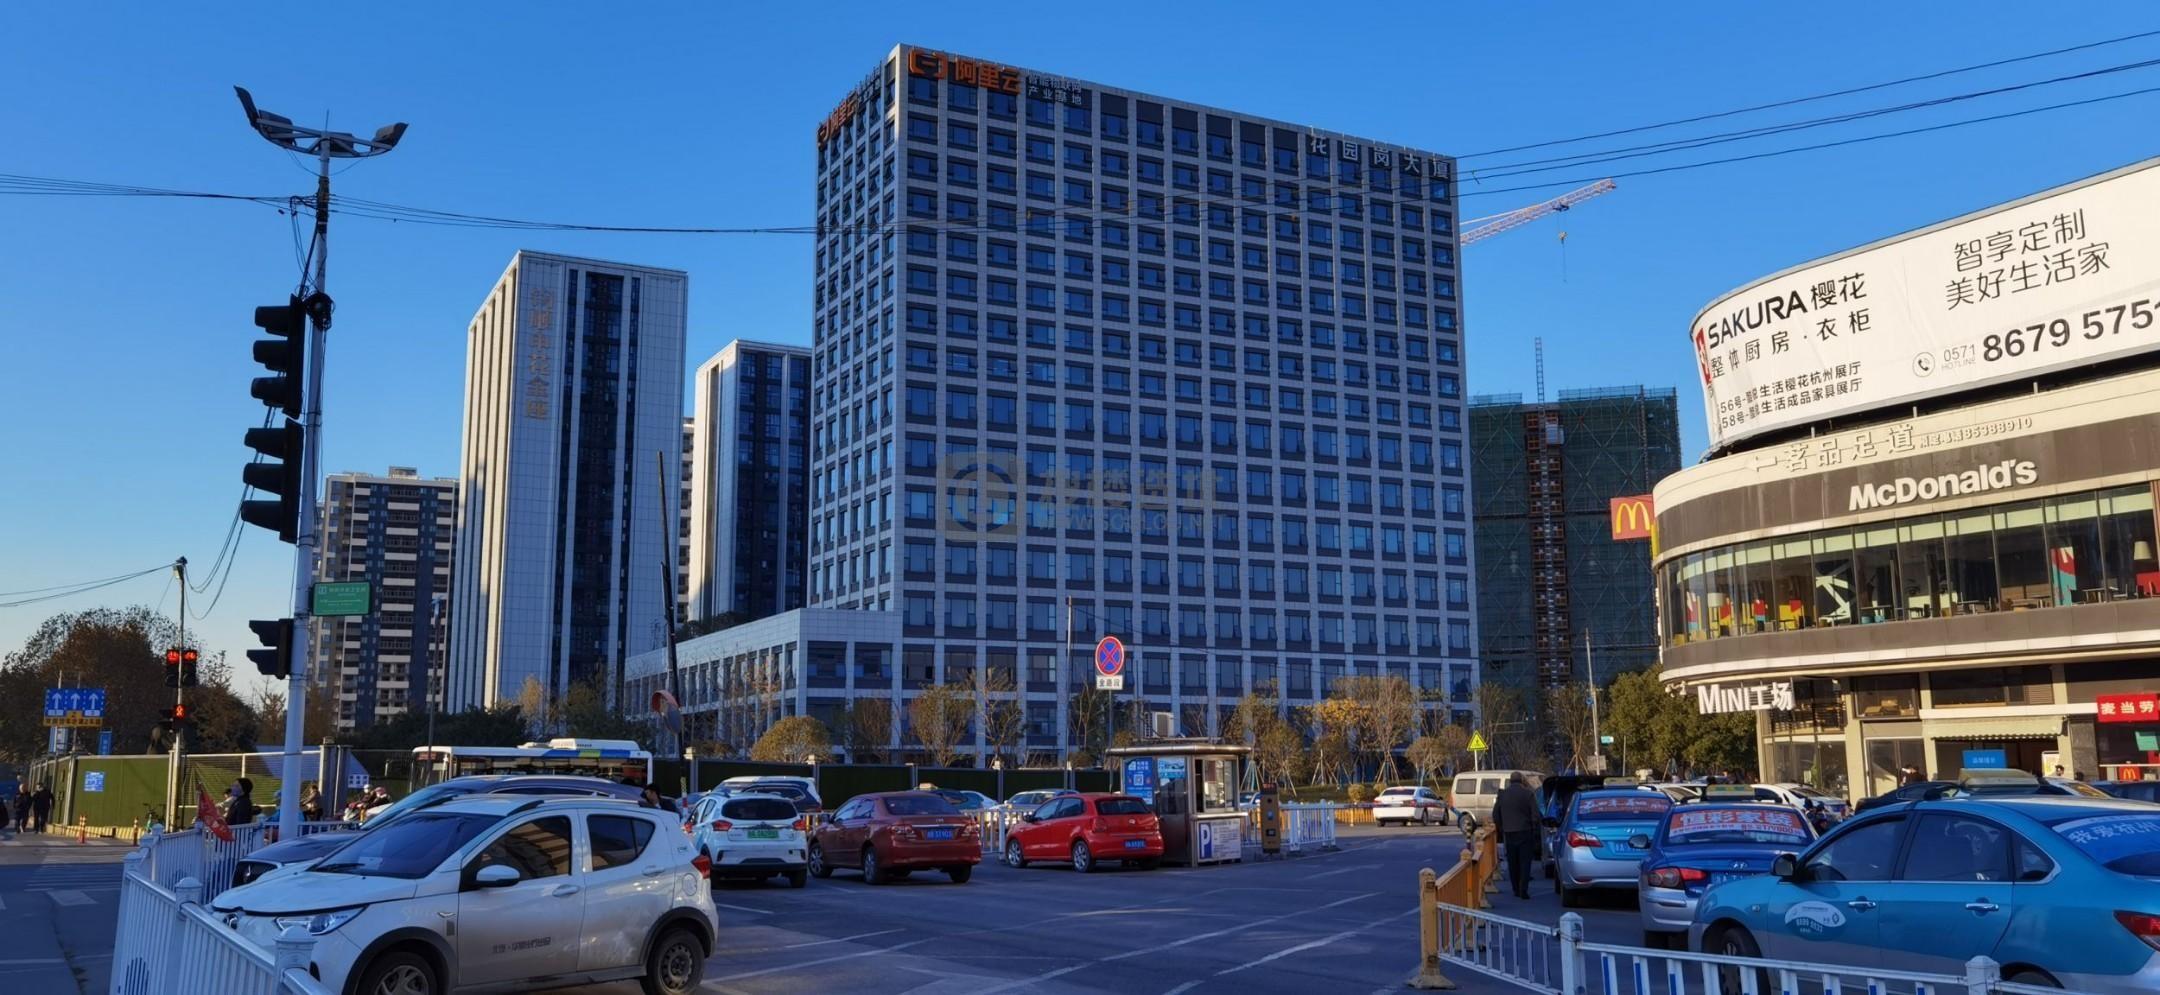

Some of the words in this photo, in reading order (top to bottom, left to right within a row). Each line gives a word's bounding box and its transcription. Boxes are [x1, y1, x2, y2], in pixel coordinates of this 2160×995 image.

[955, 59, 1021, 95] 阿里云
[1954, 208, 2086, 272] 智享定制
[1946, 242, 2110, 311] 美好生活家
[1708, 290, 1808, 349] SAKURA
[1811, 273, 1867, 311] 樱花
[1943, 344, 1975, 362] 0571
[1983, 318, 2070, 362] 8679
[2083, 299, 2160, 340] 575
[1849, 458, 2038, 511] McDonald's
[2100, 701, 2155, 715] 麦当劳
